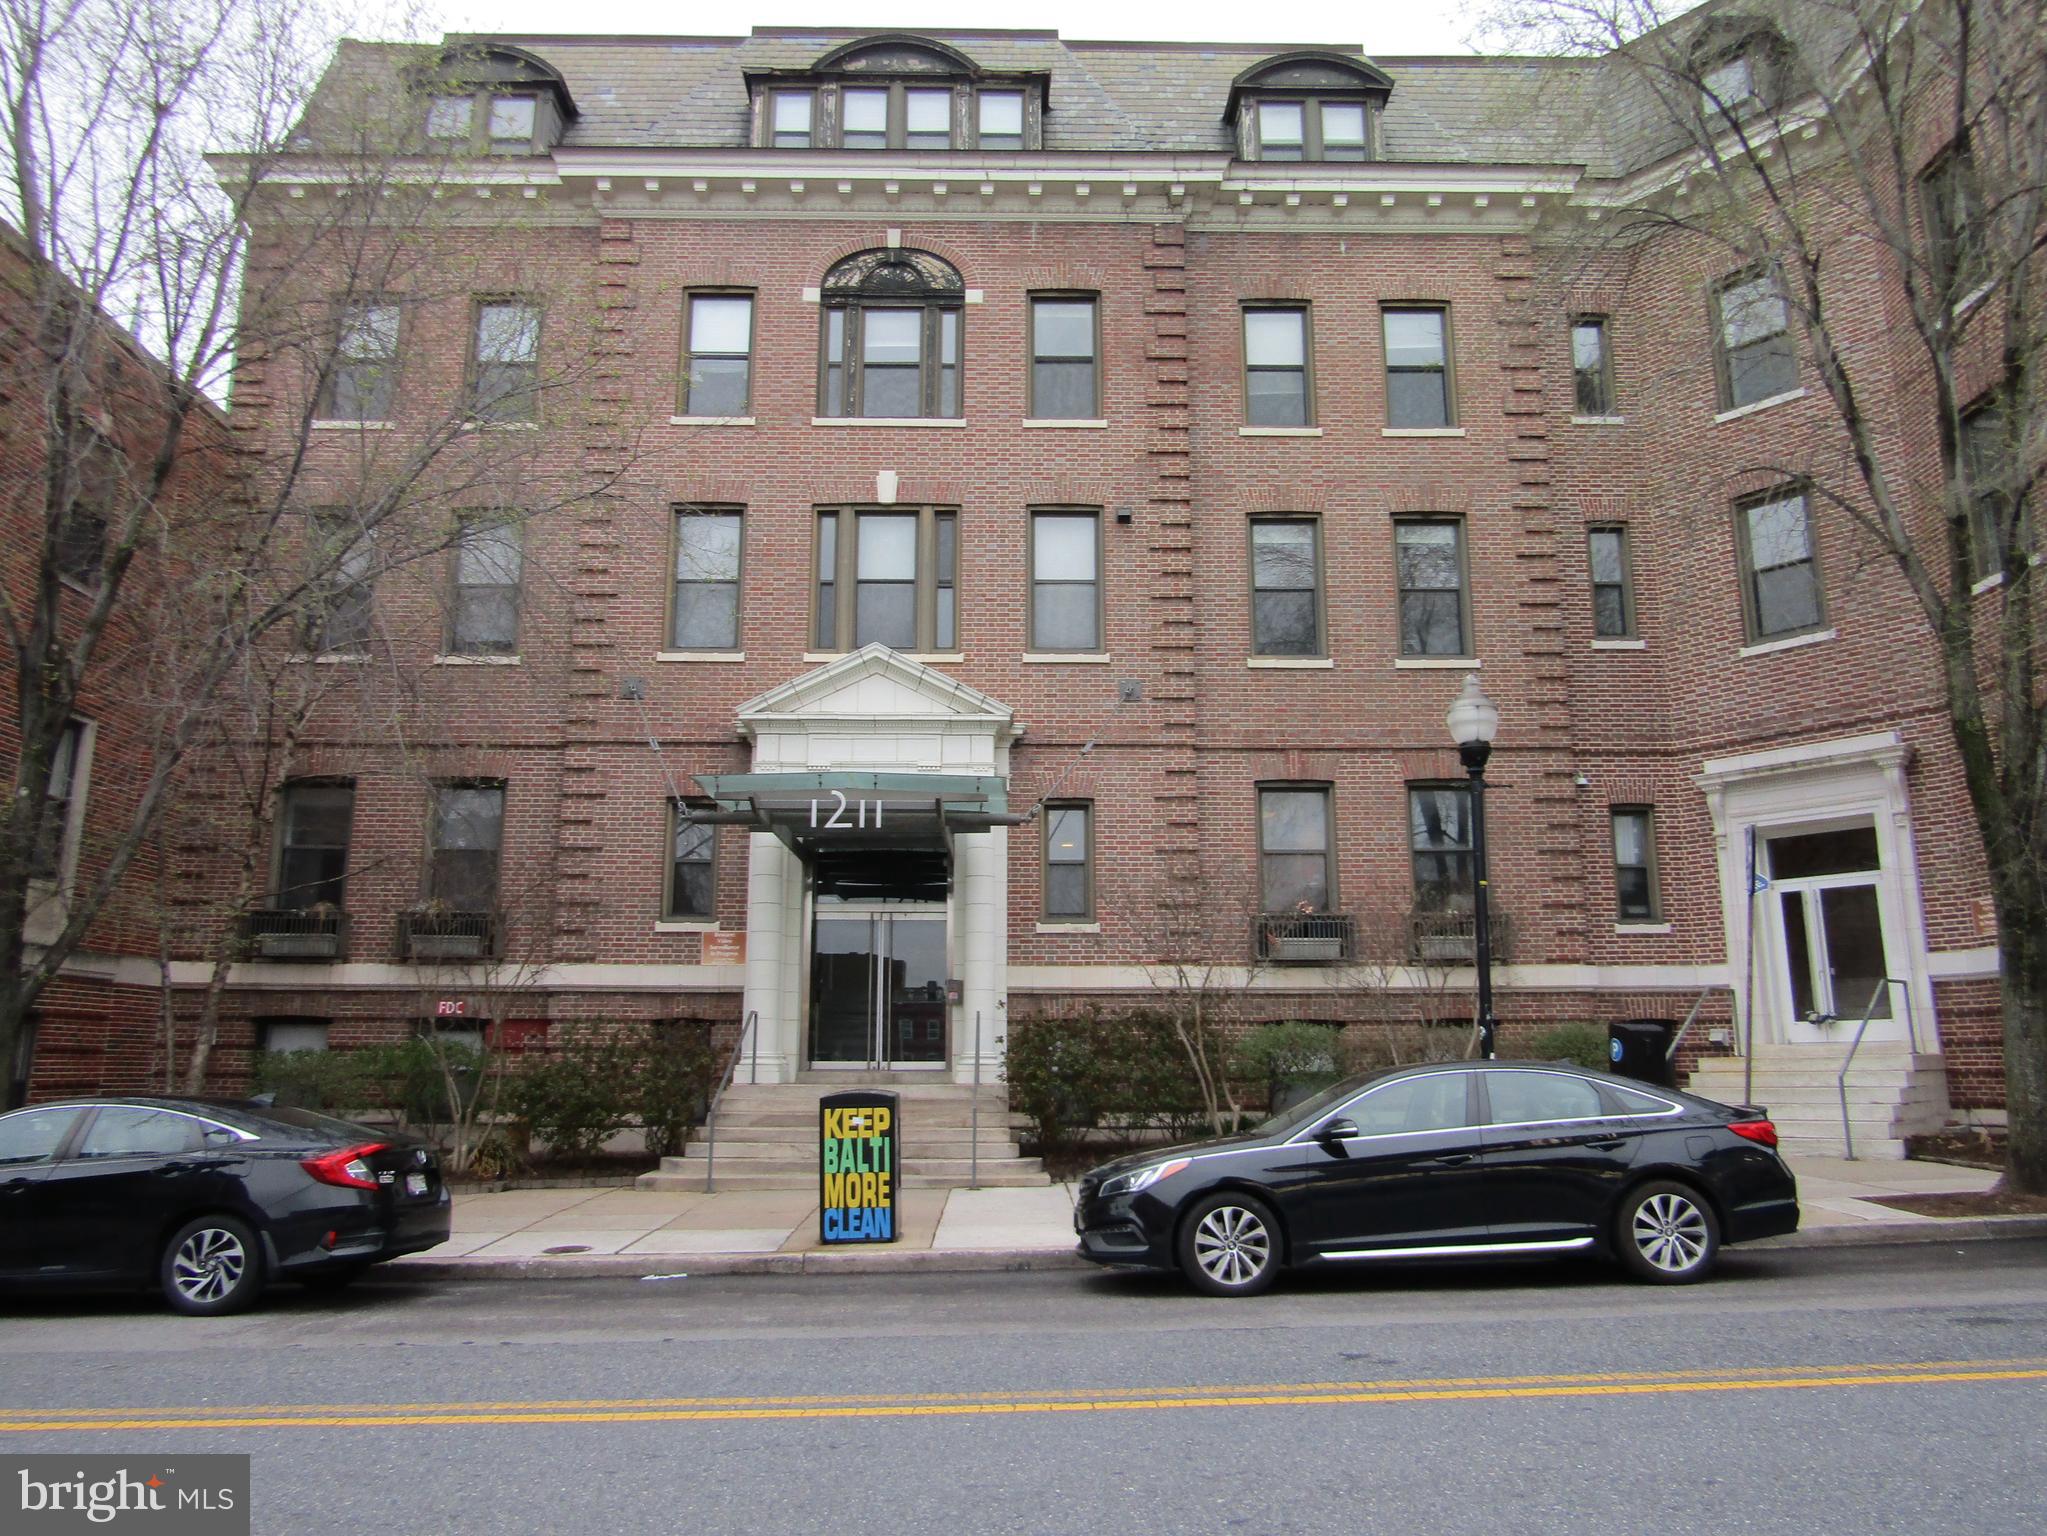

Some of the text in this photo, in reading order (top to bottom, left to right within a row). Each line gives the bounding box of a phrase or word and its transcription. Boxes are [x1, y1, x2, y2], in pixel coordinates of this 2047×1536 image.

[811, 790, 882, 828] 1211
[439, 1001, 463, 1014] FDC
[824, 1107, 890, 1138] KEEP
[824, 1137, 890, 1173] BALTI
[824, 1172, 890, 1208] MORE
[824, 1207, 891, 1240] CLEAN
